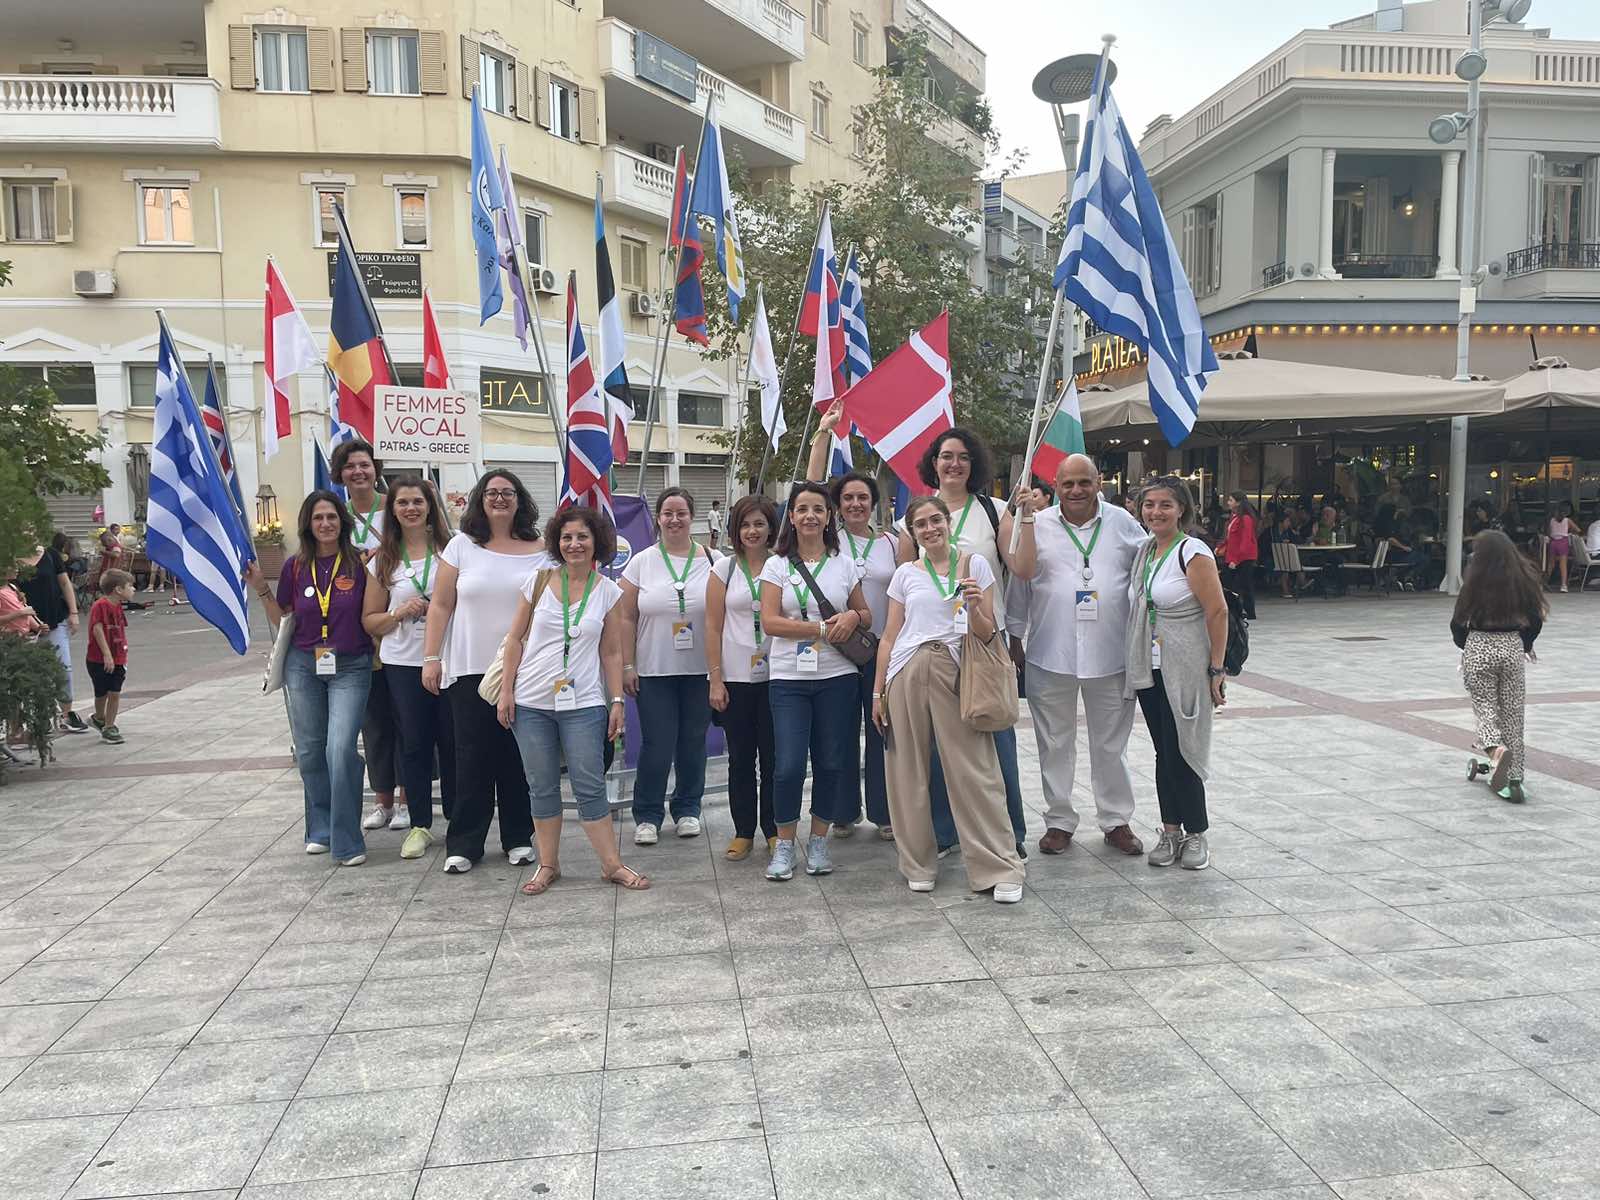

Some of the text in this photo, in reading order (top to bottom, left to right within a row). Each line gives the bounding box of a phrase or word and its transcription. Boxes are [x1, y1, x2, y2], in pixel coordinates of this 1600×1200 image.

[332, 254, 379, 262] ΔΟΡΙΚΟ
[1091, 336, 1140, 373] PLATEA
[384, 394, 466, 415] FEMMES
[384, 416, 466, 437] VOCAL
[379, 441, 420, 452] PATRAS
[429, 443, 470, 454] GREECE
